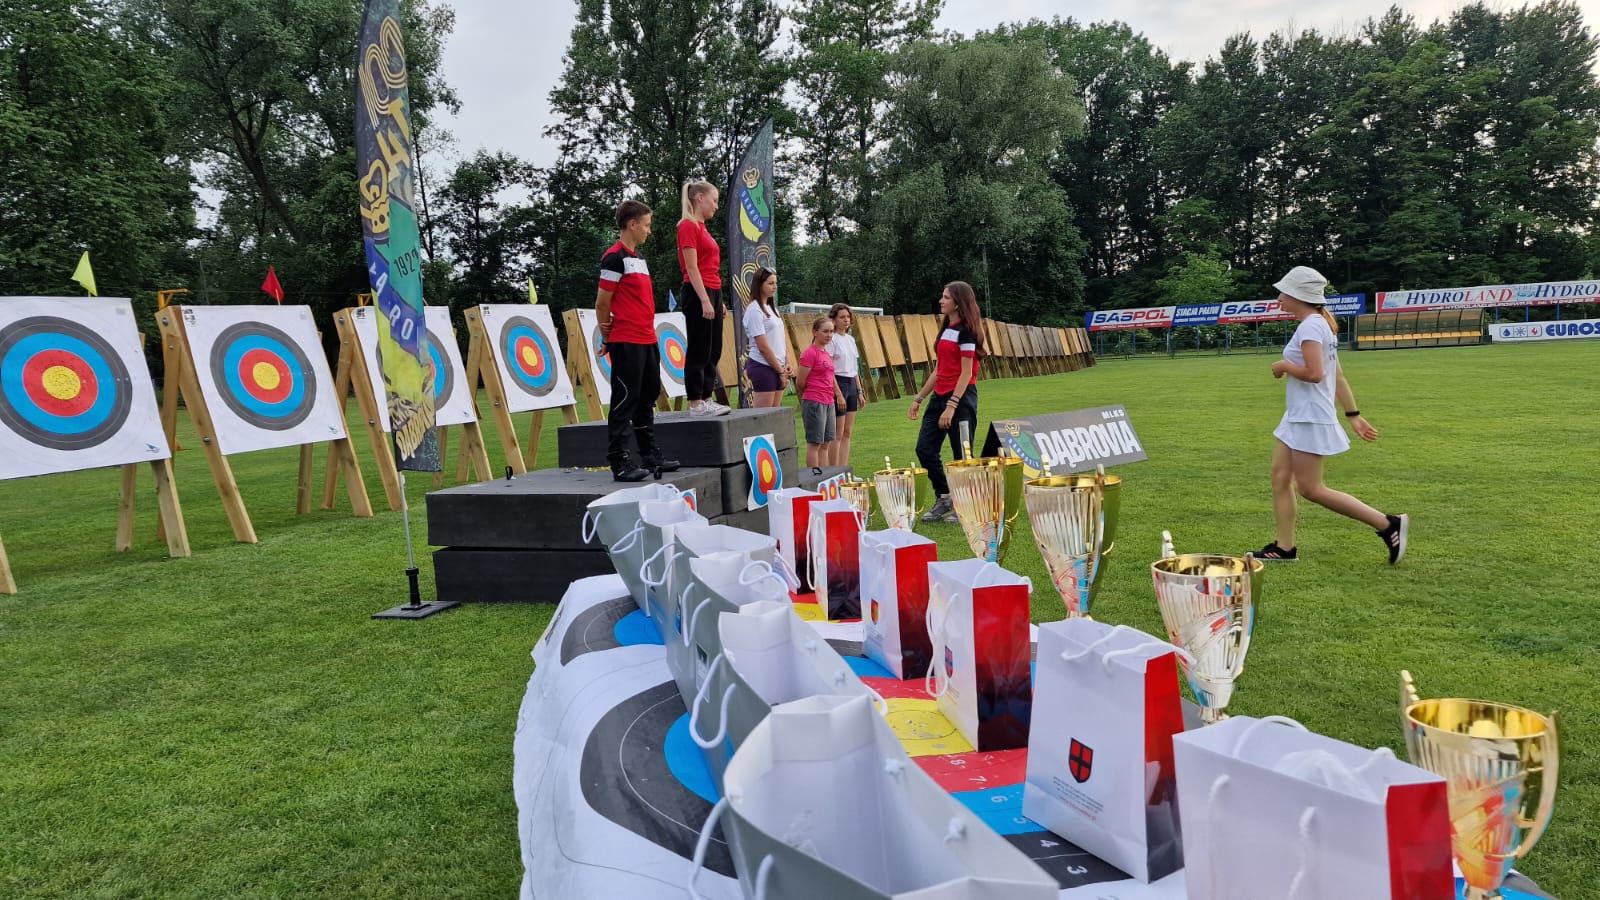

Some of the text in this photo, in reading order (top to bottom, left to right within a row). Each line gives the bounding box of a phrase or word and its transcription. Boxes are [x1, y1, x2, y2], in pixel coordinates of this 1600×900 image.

[1406, 288, 1513, 305] HYDROLAND
[1535, 283, 1600, 298] HYDRO
[1094, 309, 1170, 324] SASPOL
[1101, 408, 1125, 420] MLKS
[1034, 420, 1142, 468] DĄBROVIA
[1040, 839, 1060, 848] 4
[1067, 865, 1089, 875] 3
